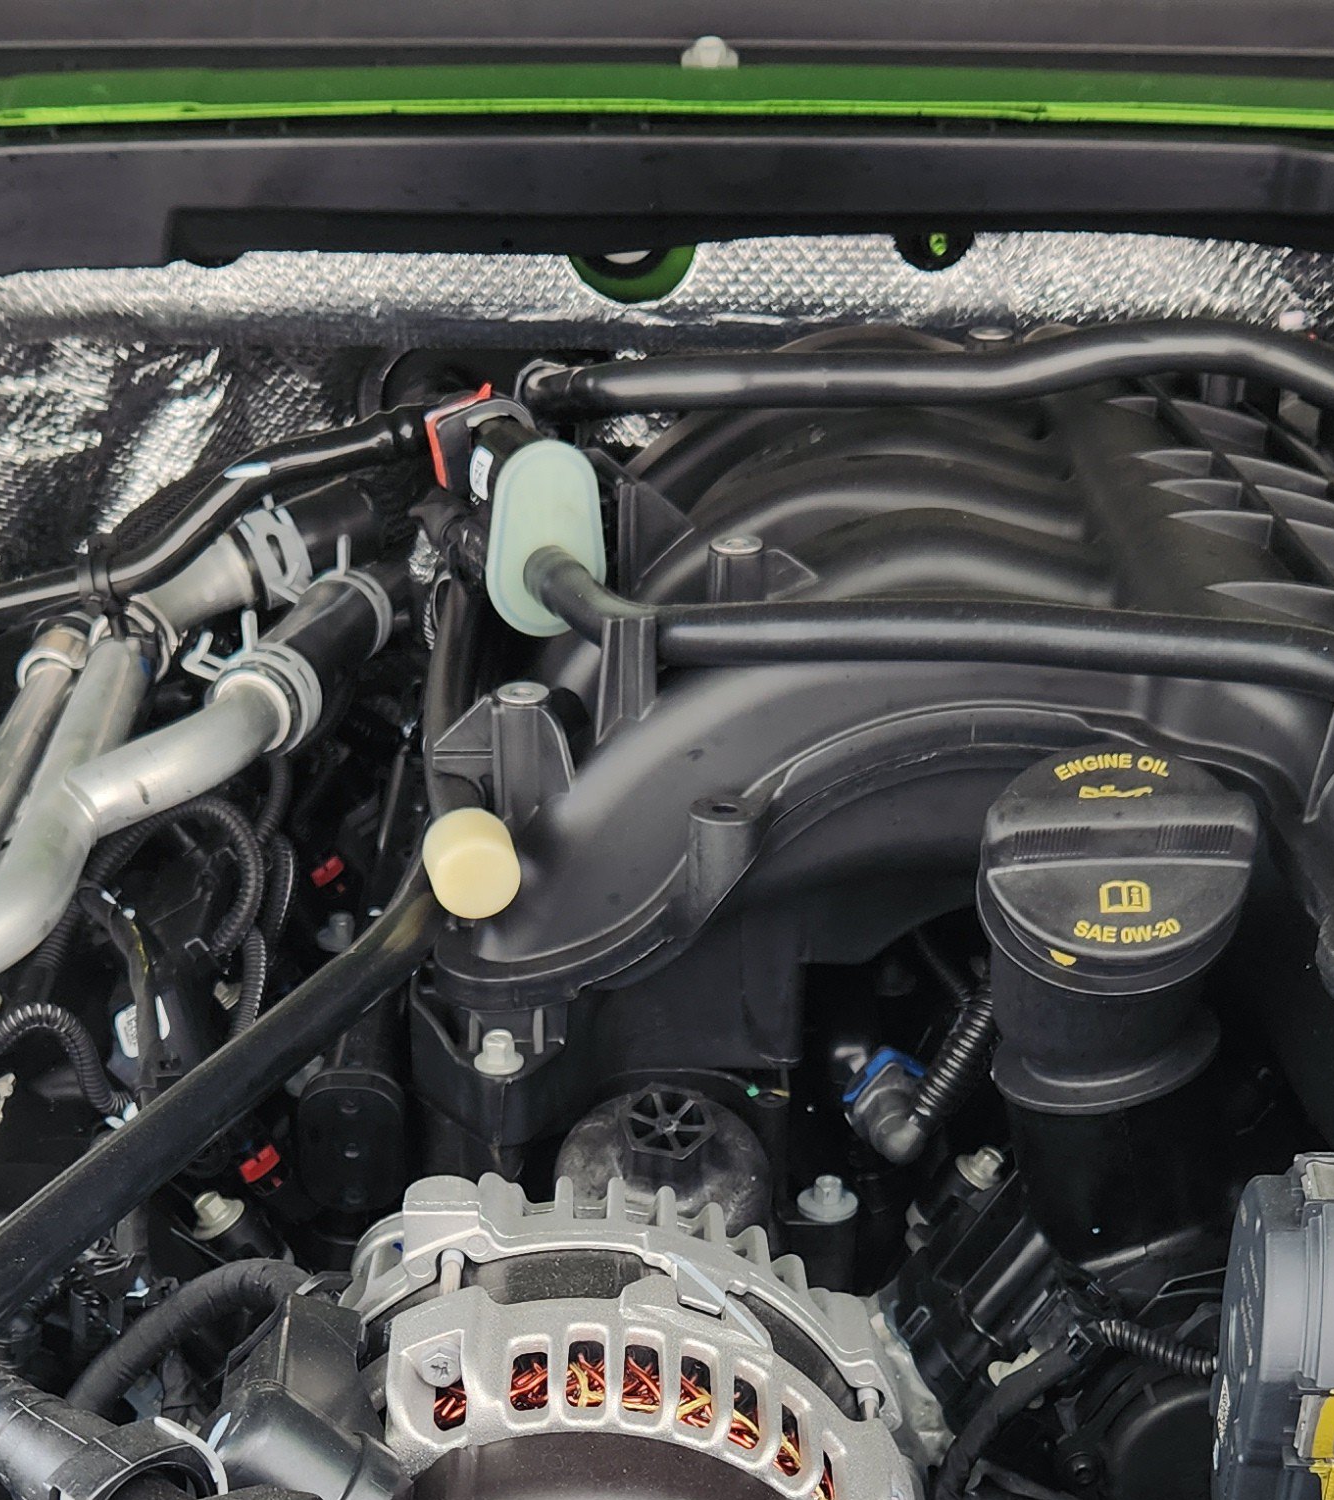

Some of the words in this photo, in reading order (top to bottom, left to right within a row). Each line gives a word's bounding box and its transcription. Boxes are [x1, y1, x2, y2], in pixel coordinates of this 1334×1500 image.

[1053, 753, 1133, 782] ENGINE
[1137, 755, 1170, 778] OIL
[1073, 919, 1117, 943] SAE
[1120, 918, 1182, 944] 0W-20
